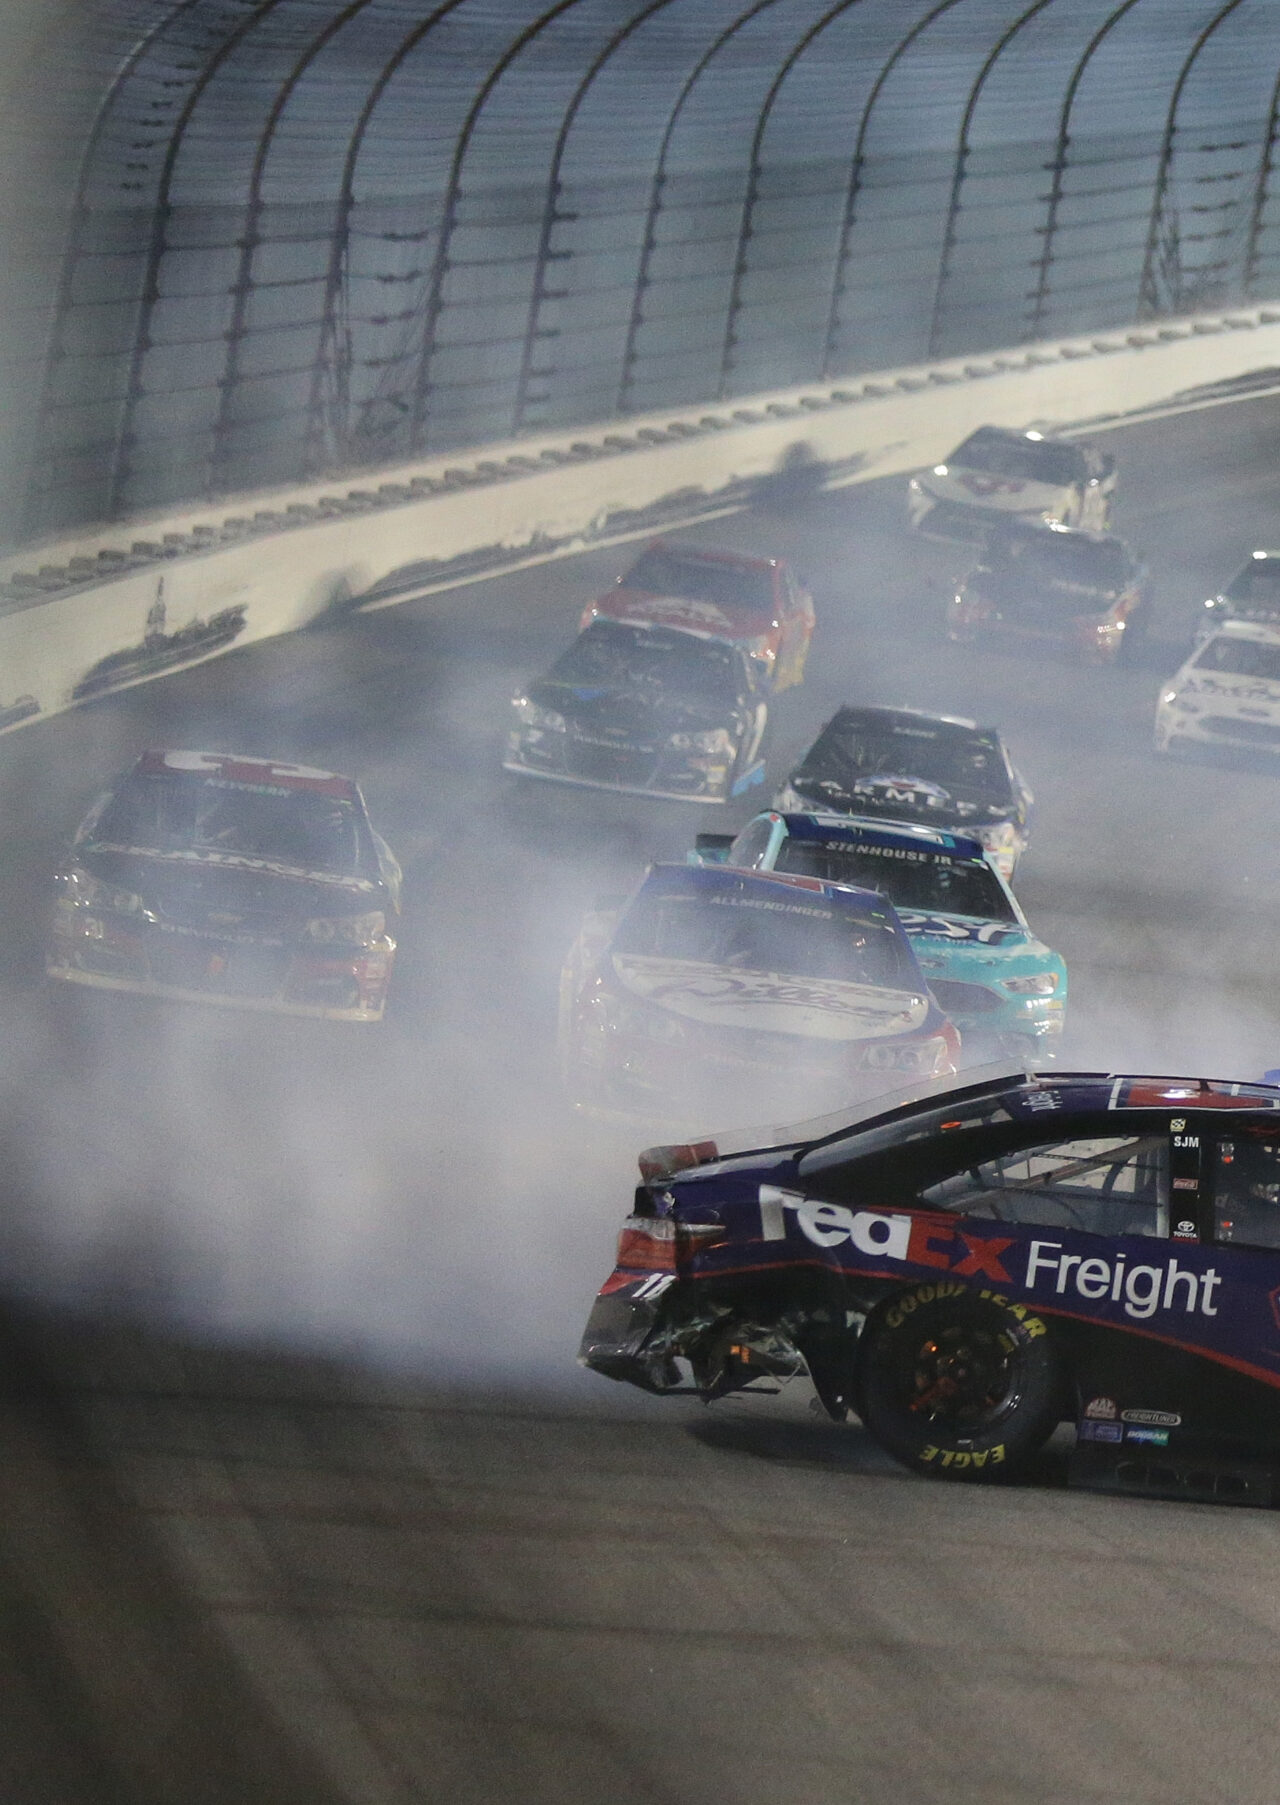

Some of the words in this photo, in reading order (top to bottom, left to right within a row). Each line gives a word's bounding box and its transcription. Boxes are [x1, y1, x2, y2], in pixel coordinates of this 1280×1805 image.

[825, 840, 927, 860] STENHOUSE
[711, 896, 832, 920] ALLMENDINGER
[1174, 1136, 1199, 1148] SJM
[1173, 1231, 1197, 1239] TOYOTA
[1025, 1240, 1222, 1319] Freight
[919, 1444, 1006, 1468] EAGLE
